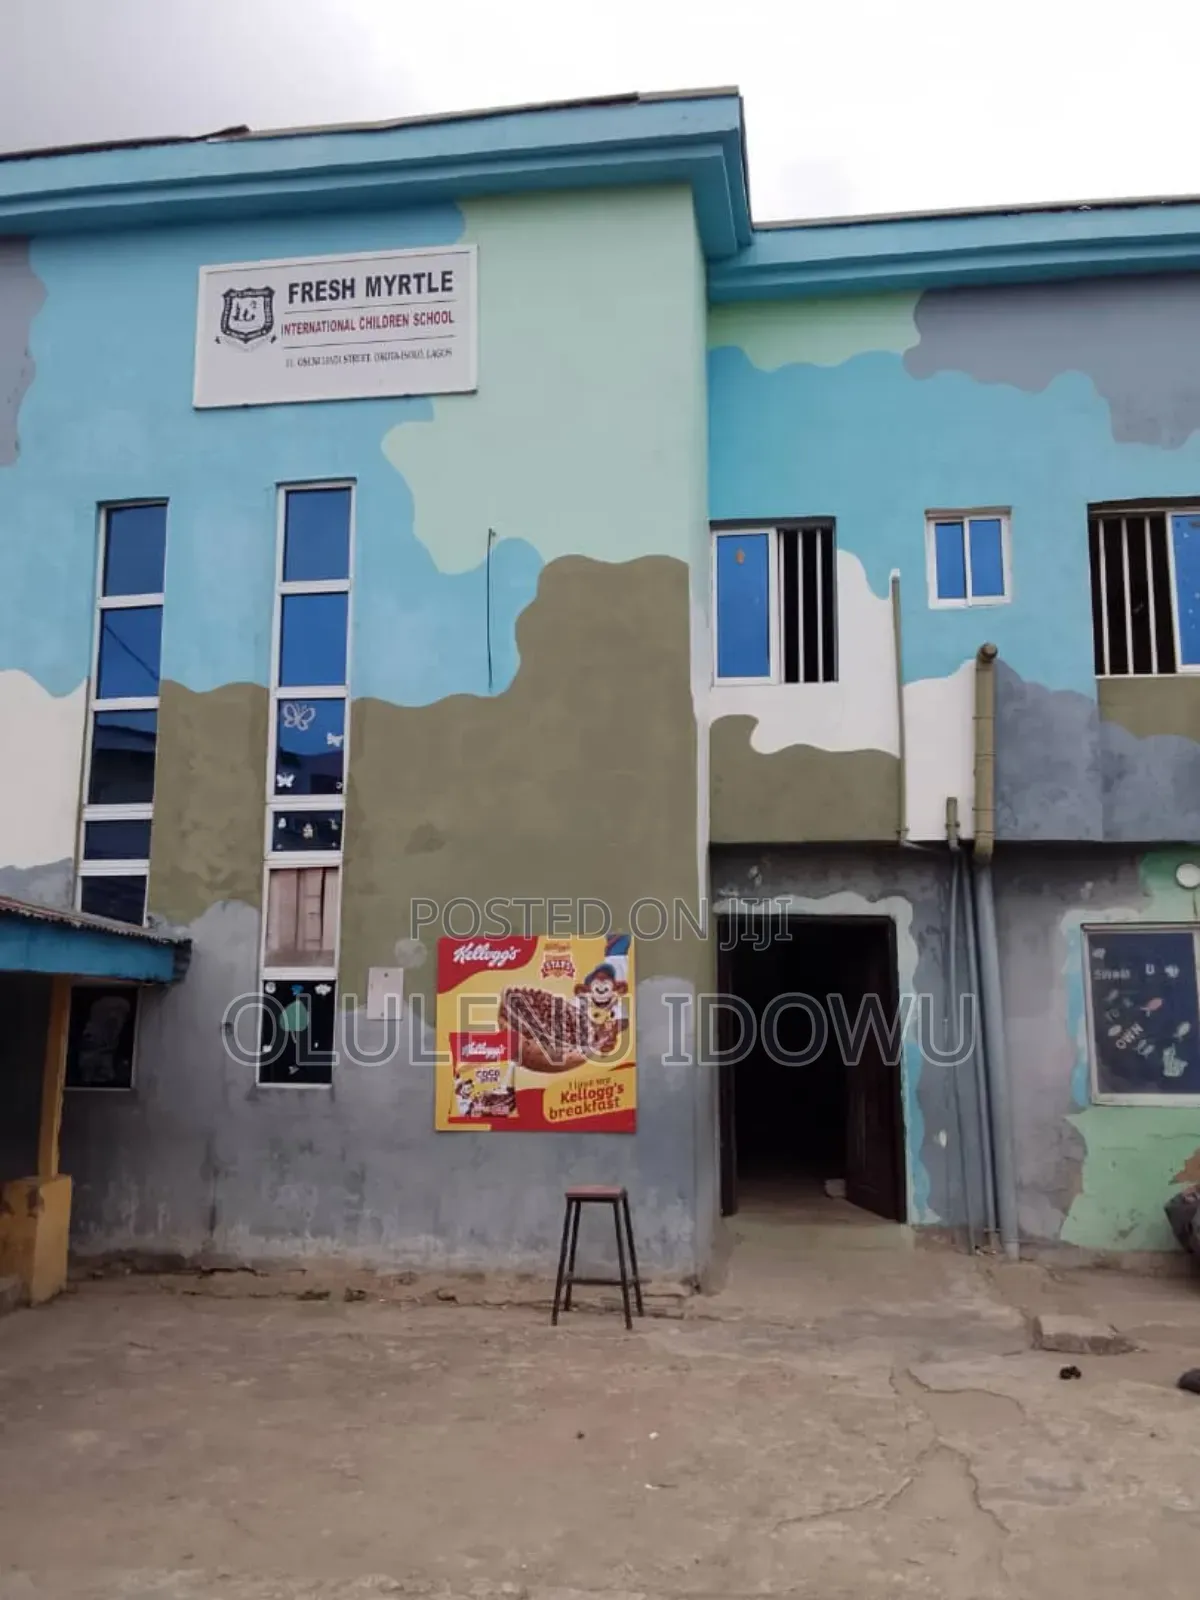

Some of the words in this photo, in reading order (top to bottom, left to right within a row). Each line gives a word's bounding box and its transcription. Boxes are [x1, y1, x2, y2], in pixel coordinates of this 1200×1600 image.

[288, 278, 355, 304] FRESH
[365, 271, 453, 297] MYRTLE
[281, 320, 356, 336] INTERNATIONAL
[359, 315, 409, 330] CHILDREN
[413, 311, 454, 326] SCHOOL
[453, 942, 521, 967] Kellogg's
[561, 1082, 624, 1104] Kellogg's
[549, 1096, 620, 1119] breakfast
